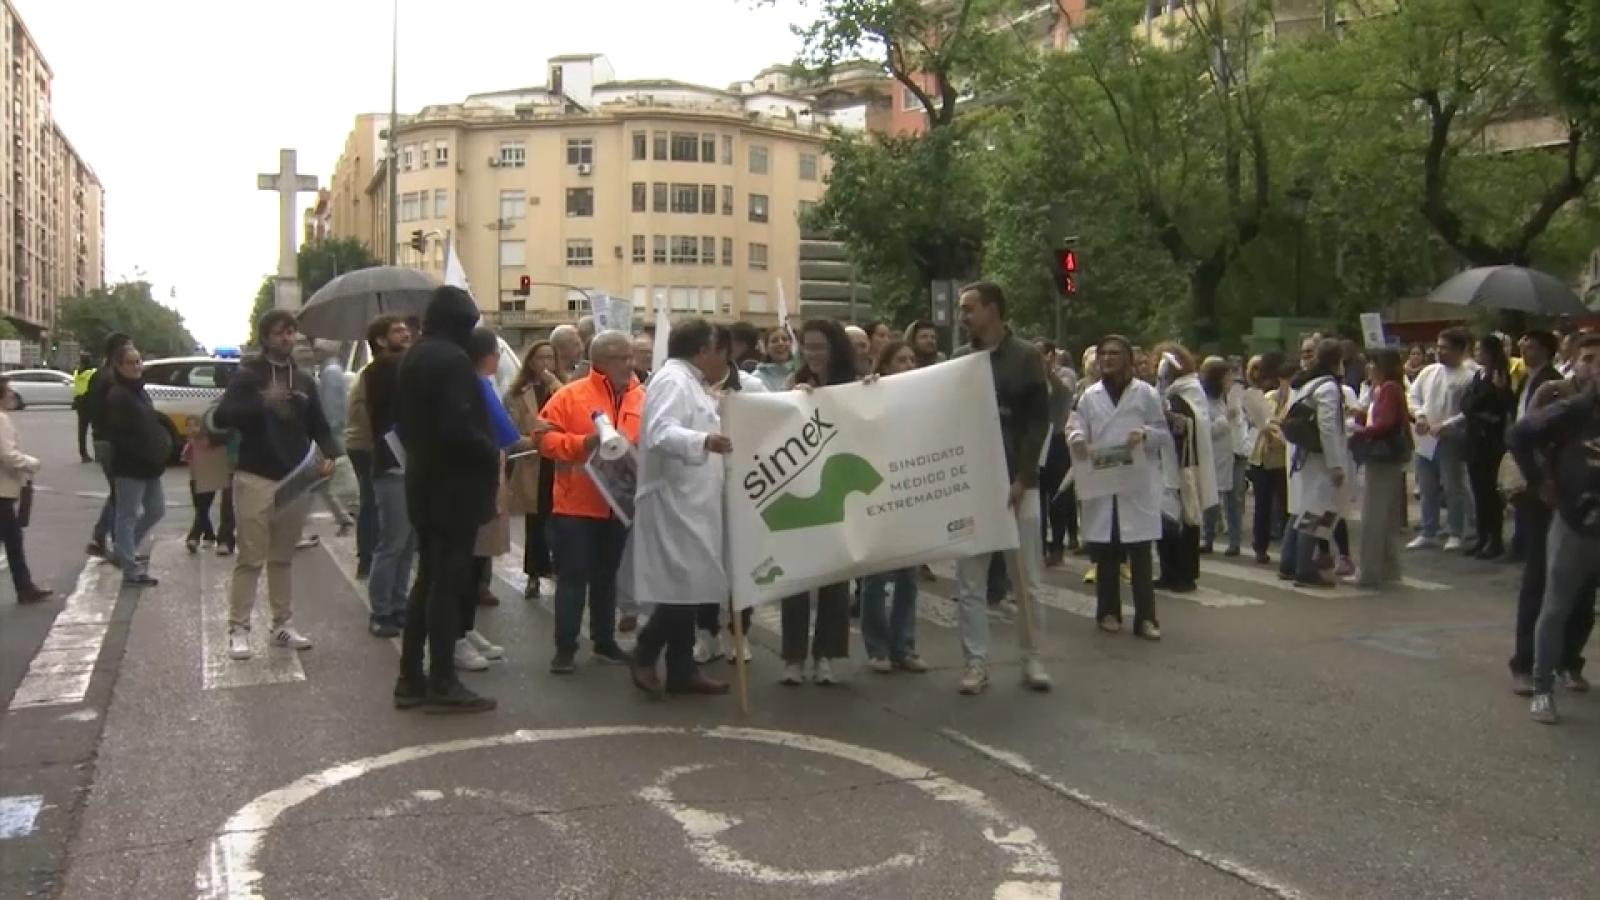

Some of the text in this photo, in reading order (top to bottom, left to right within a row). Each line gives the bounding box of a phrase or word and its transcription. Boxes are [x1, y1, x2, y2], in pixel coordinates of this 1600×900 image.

[743, 408, 834, 499] simex
[888, 446, 964, 472] SINDICATO
[951, 465, 968, 477] DE
[866, 481, 970, 516] EXTREMADURA
